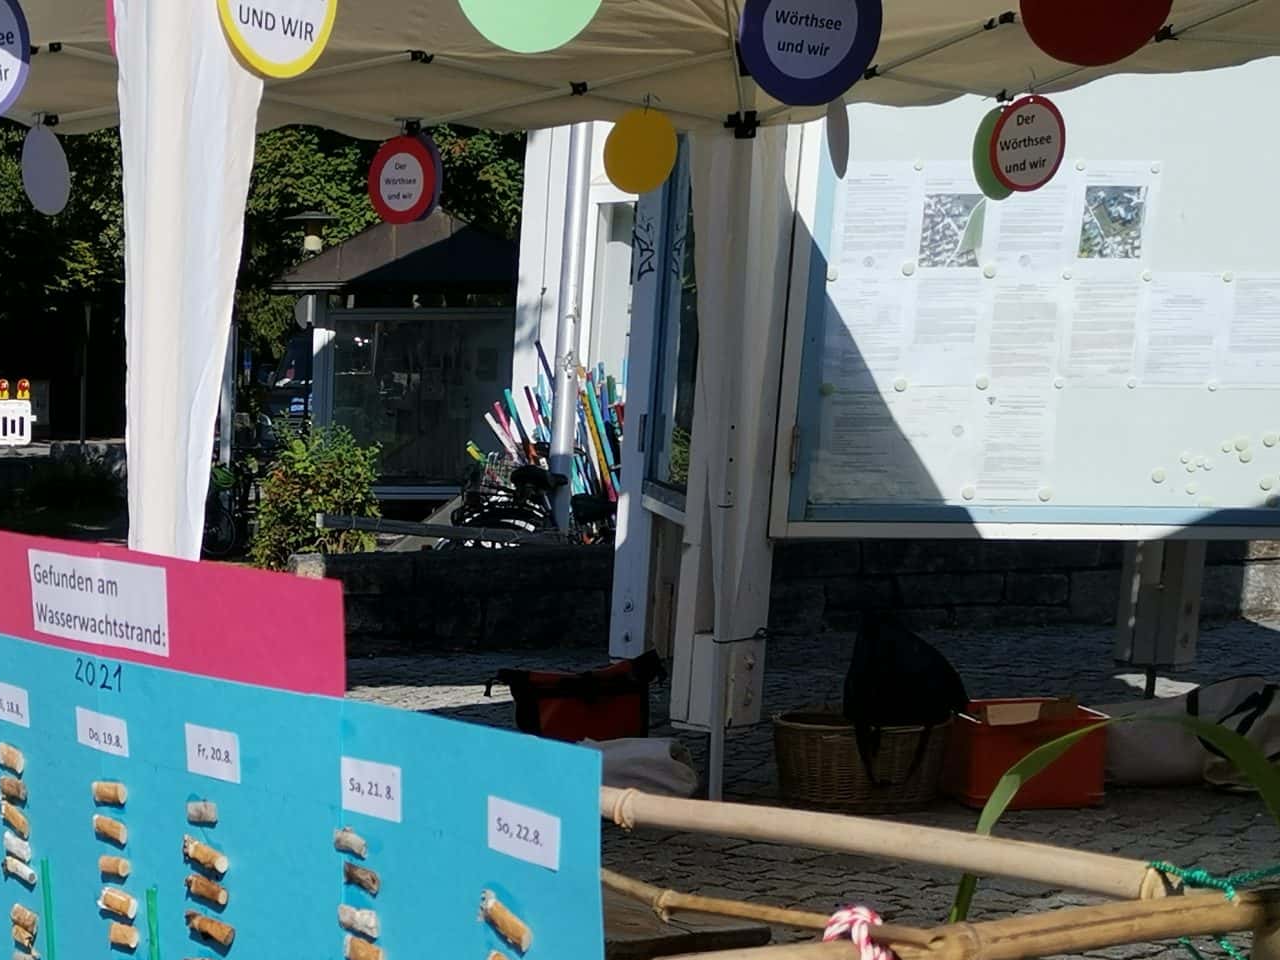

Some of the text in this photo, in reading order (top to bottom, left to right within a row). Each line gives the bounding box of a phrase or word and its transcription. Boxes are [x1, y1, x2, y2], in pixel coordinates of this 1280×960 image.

[238, 4, 314, 43] UND WIR
[775, 9, 842, 31] Wörthsee
[777, 40, 831, 57] und wir
[1016, 114, 1035, 126] Der
[999, 134, 1052, 151] Wörthsee
[1005, 157, 1047, 173] und wir
[33, 563, 118, 597] Gefunden am
[35, 602, 167, 648] Wasserwachtstrand:
[75, 657, 123, 693] 2021
[89, 728, 122, 749] Do, 19.8.
[197, 744, 208, 760] Fr,
[349, 777, 364, 796] Sa,
[496, 817, 543, 847] So, 22.8.
